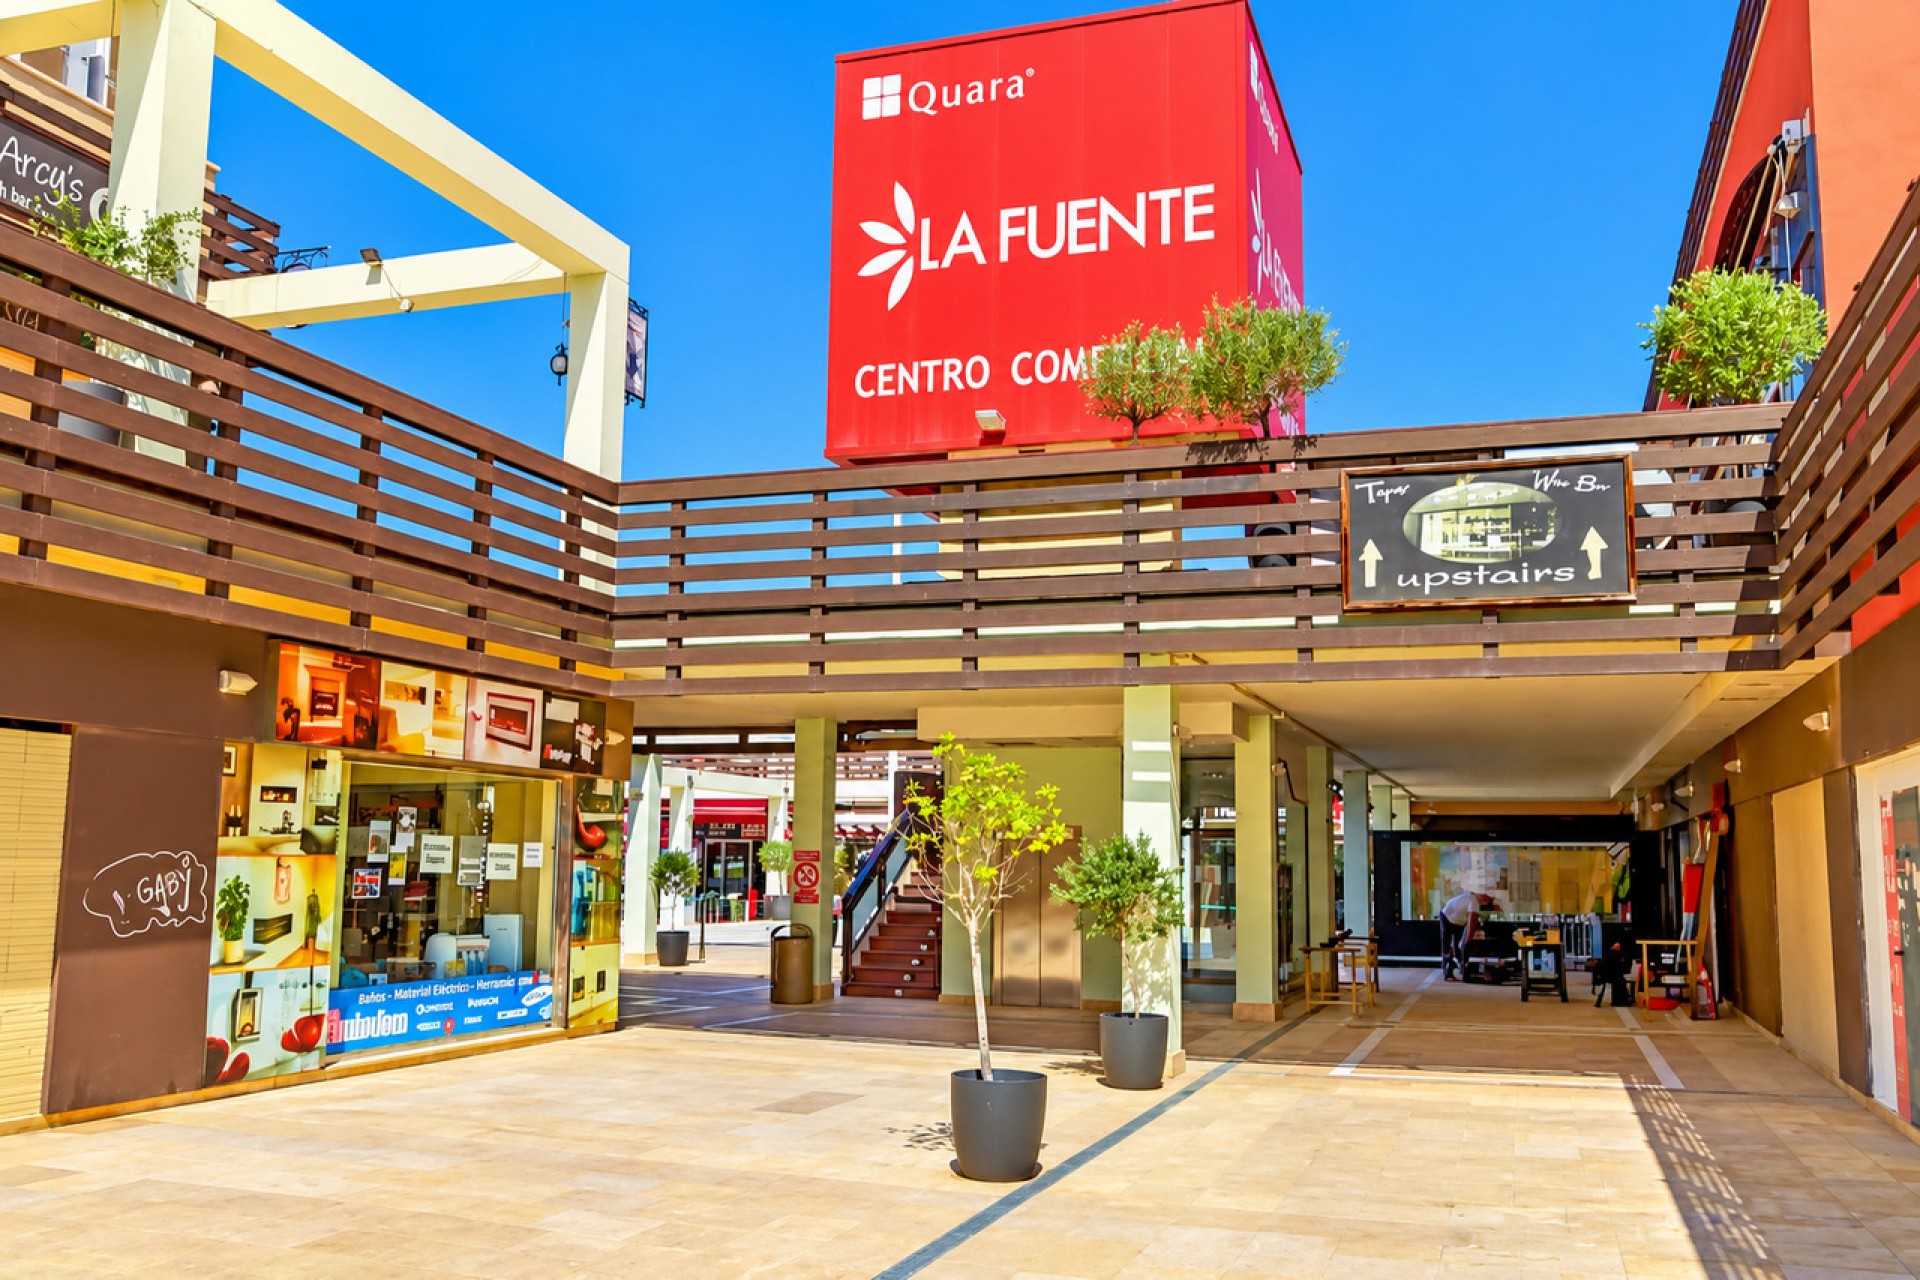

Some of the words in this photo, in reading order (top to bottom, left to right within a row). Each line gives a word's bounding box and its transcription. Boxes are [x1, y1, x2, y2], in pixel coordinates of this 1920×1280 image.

[0, 135, 84, 206] Arcy's
[11, 185, 33, 210] bar
[920, 210, 987, 270] LA
[1000, 184, 1215, 263] FUENTE
[854, 355, 990, 399] CENTRO
[1397, 562, 1575, 595] upstairs
[394, 986, 431, 1000] Material
